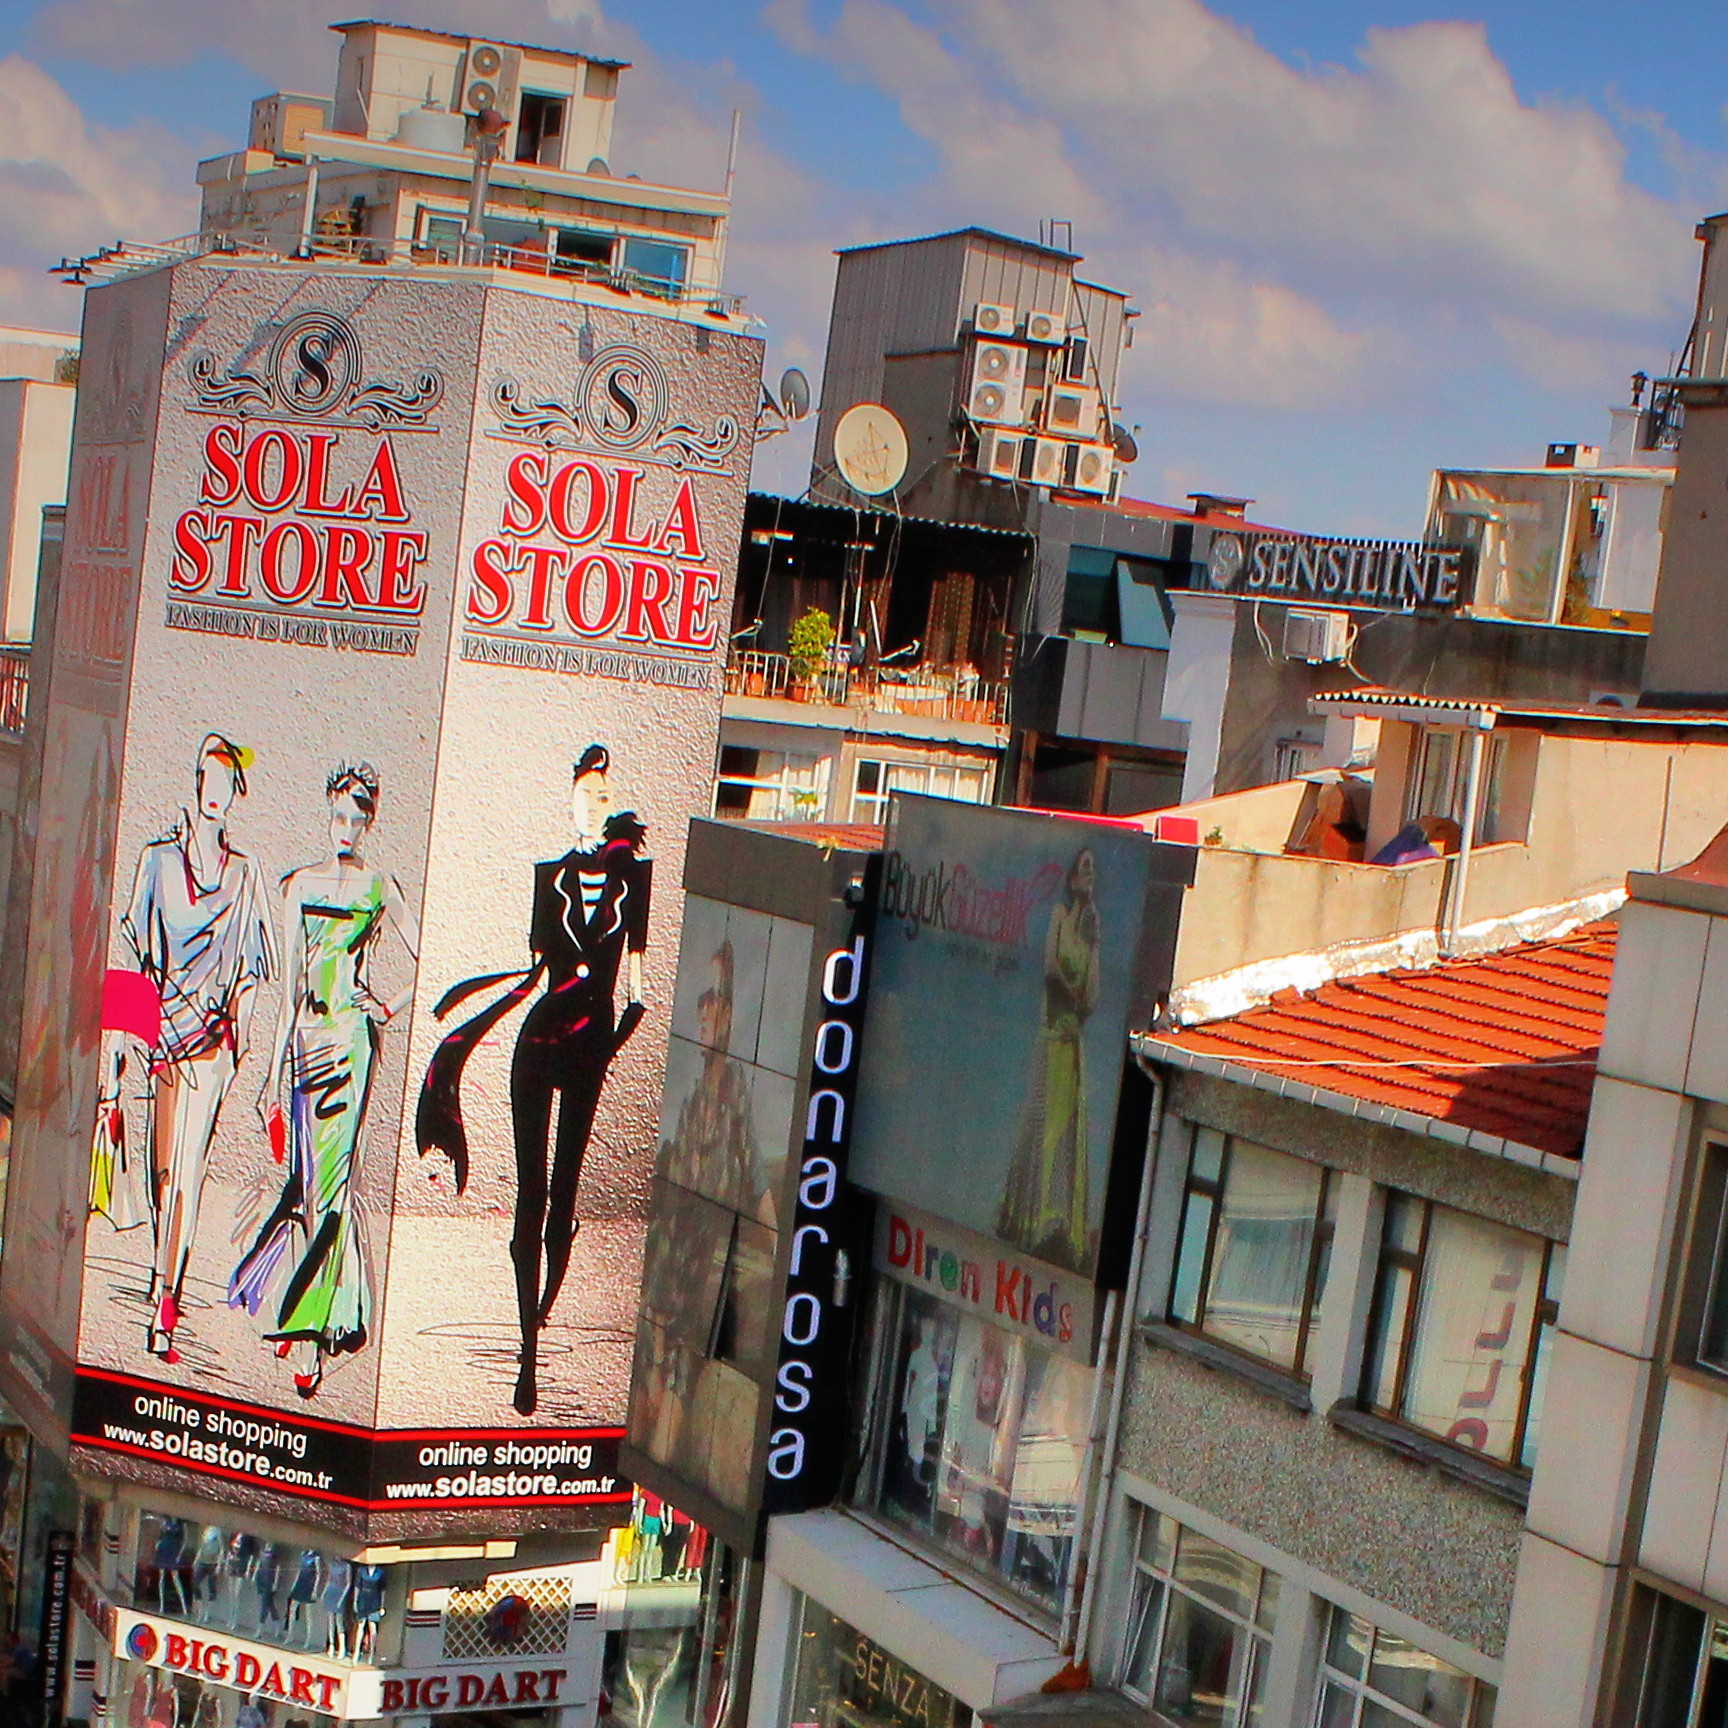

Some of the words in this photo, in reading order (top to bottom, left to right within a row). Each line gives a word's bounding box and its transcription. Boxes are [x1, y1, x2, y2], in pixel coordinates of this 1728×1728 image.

[293, 334, 335, 402] S
[603, 367, 643, 435] S
[199, 423, 410, 521] SOLA
[500, 452, 707, 561] SOLA
[169, 509, 427, 614] STORE
[465, 538, 721, 650] STORE
[1248, 538, 1461, 603] SENSILINE
[165, 603, 257, 638] FASHION
[258, 612, 280, 641] IS
[282, 617, 327, 647] FOR
[329, 622, 419, 656] WOMEN
[461, 636, 557, 671] FASHION
[561, 647, 583, 673] IS
[584, 650, 630, 680] FOR
[631, 657, 712, 689] WOMEN
[767, 935, 865, 1480] donarosa
[995, 1260, 1072, 1343] Kids
[104, 1424, 333, 1490] www.solastore.com.tr
[135, 1396, 200, 1427] online
[206, 1410, 307, 1458] shopping
[419, 1441, 488, 1466] online
[493, 1440, 592, 1470] shopping
[386, 1470, 615, 1498] www.solastore.com.tr
[165, 1633, 230, 1678] BIG
[234, 1651, 342, 1711] DART
[380, 1675, 451, 1713] BIG
[456, 1668, 568, 1706] DART
[855, 1642, 929, 1728] SENZA
